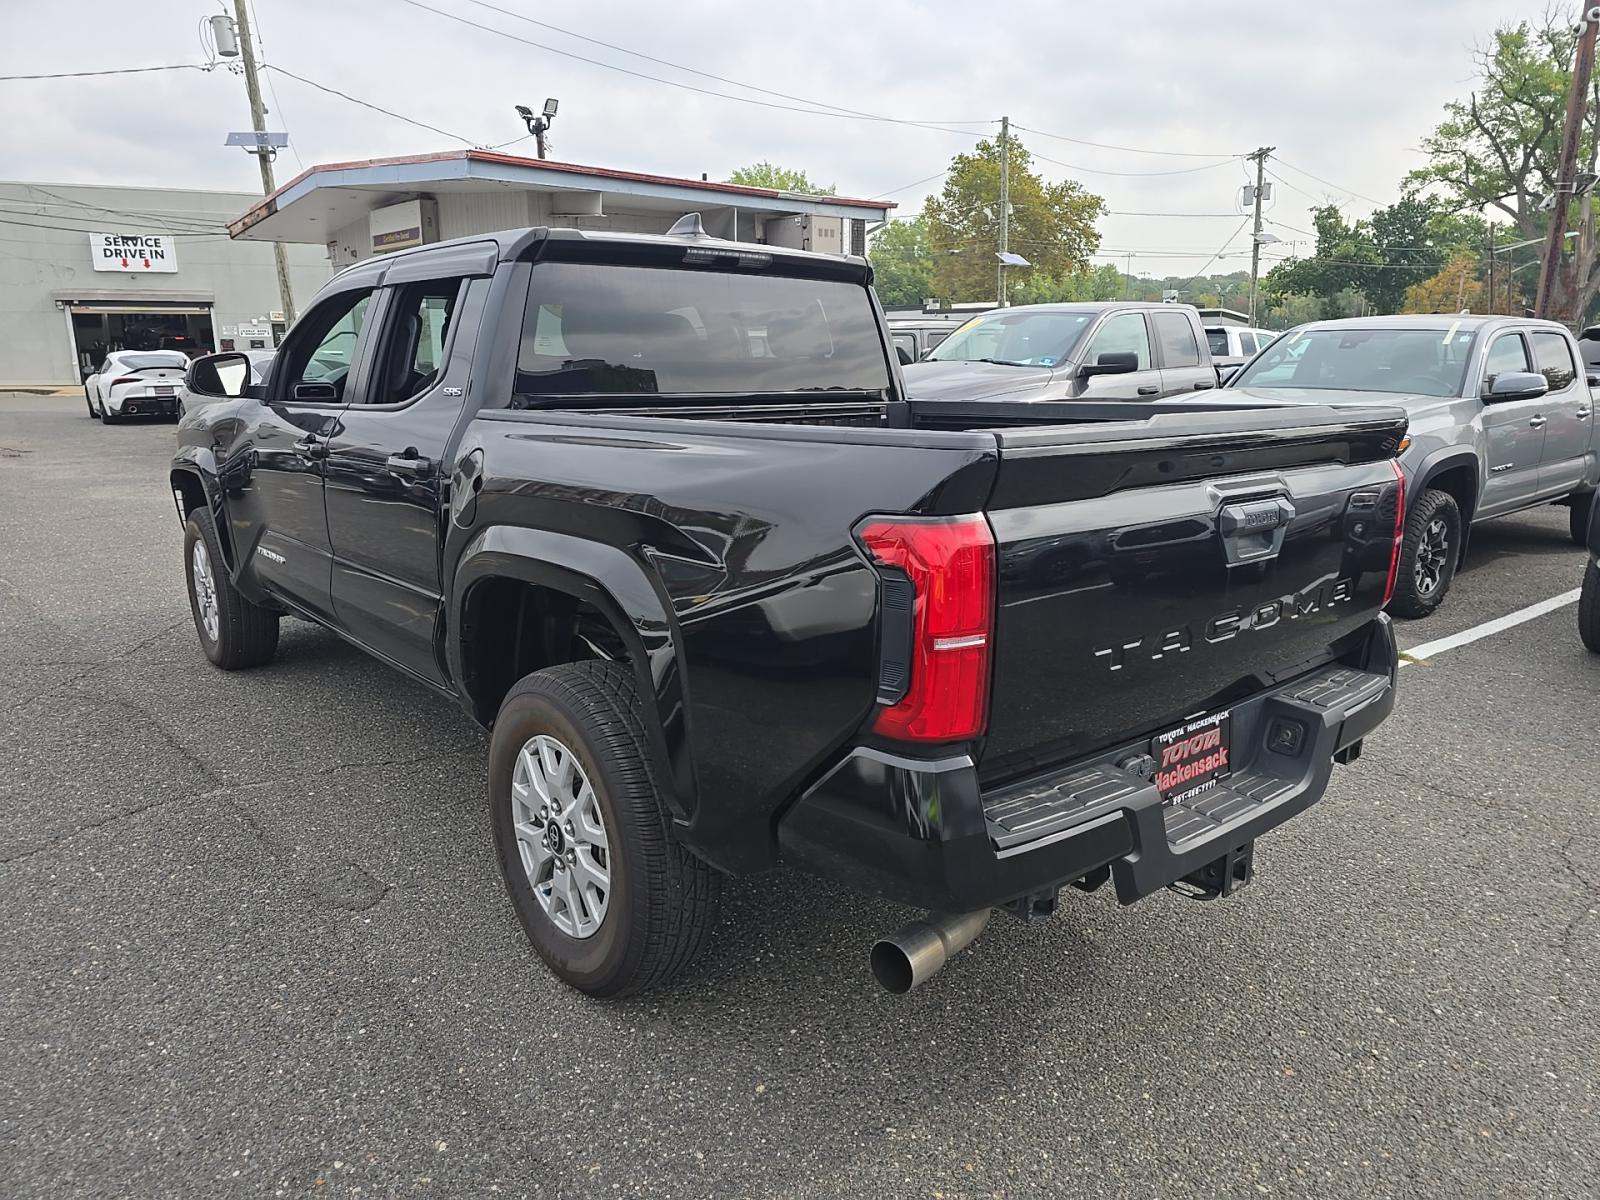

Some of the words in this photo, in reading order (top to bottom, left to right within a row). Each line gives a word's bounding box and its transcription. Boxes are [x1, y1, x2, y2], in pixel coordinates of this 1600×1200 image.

[103, 248, 147, 259] DRIVE
[149, 249, 165, 260] IN
[104, 236, 162, 248] SERVICE
[1245, 510, 1279, 527] TOYOTA
[1094, 577, 1352, 671] TACOMA
[1159, 726, 1185, 744] TOYOTA
[1187, 710, 1230, 733] HACKENSACK
[1161, 727, 1221, 769] TOYOTA
[1154, 746, 1229, 792] Hackensack
